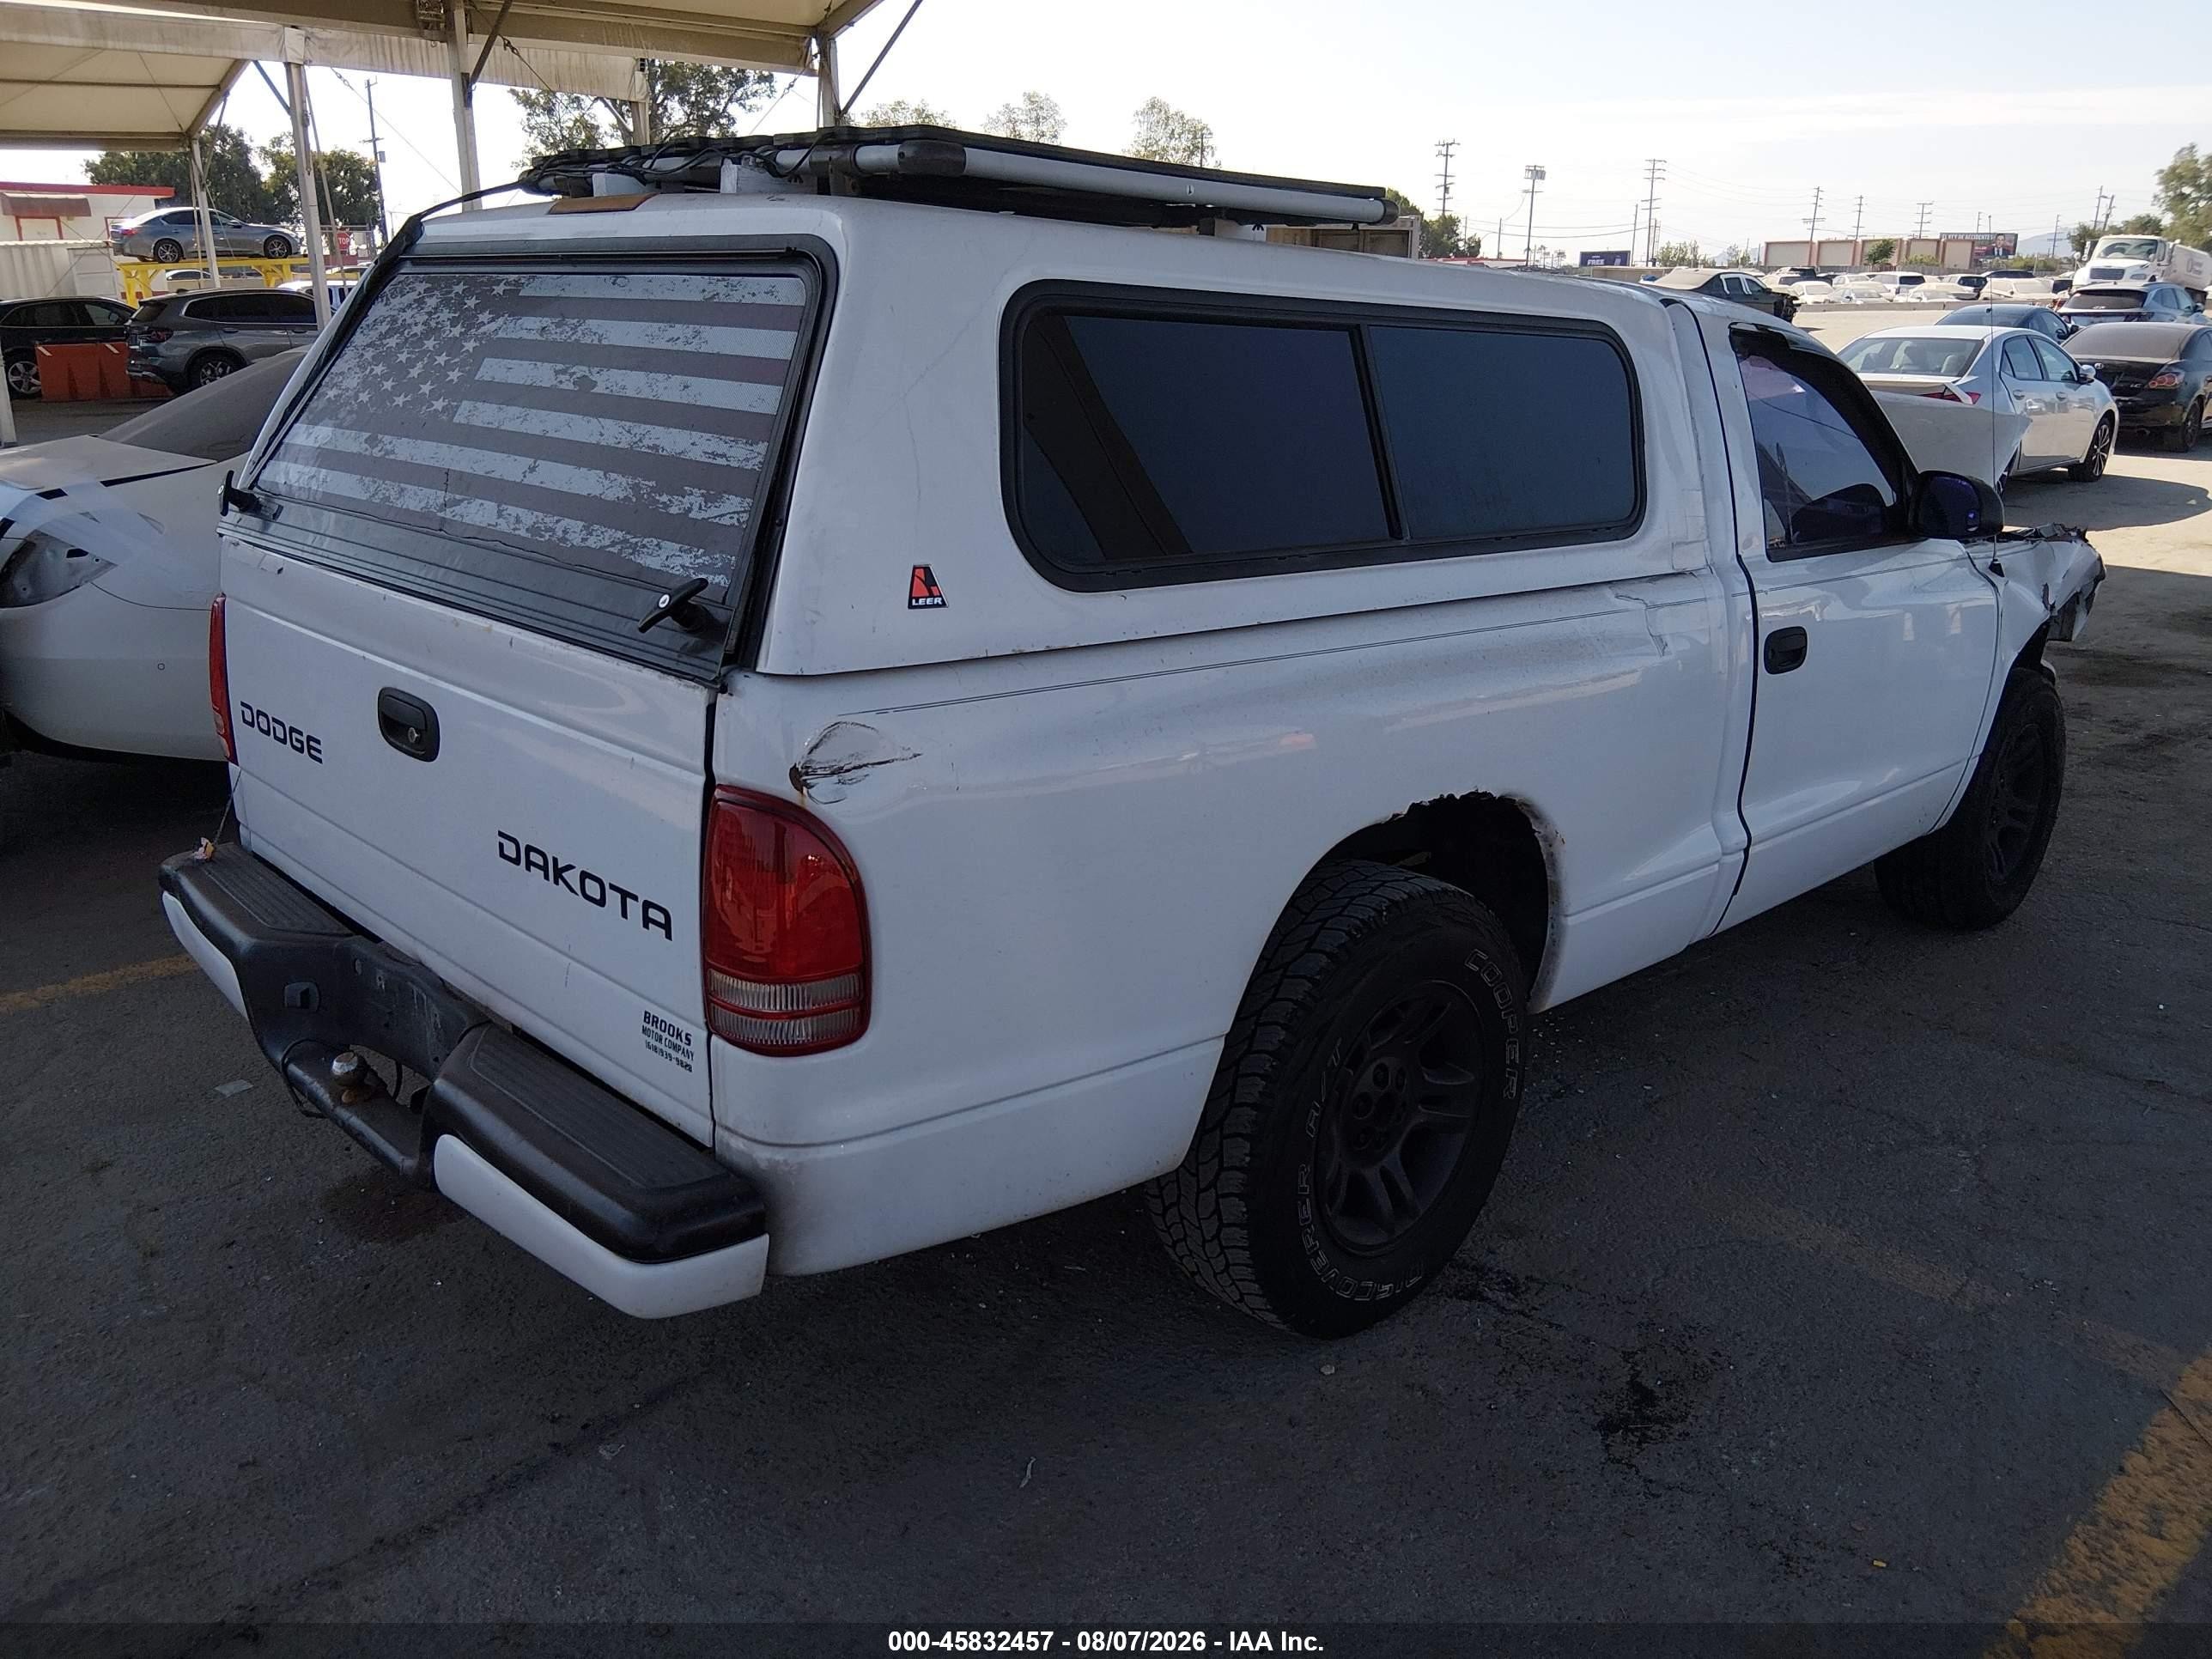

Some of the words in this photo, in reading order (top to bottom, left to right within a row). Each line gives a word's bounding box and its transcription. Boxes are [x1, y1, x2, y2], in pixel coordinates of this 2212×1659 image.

[337, 237, 350, 246] TOP
[912, 597, 943, 606] LEER
[240, 700, 324, 765] DODGE
[497, 830, 673, 942] DAKOTA
[641, 1024, 664, 1045] MOTOR
[664, 1037, 695, 1061] COMPANY
[643, 1010, 693, 1047] BROOKS
[1462, 948, 1519, 1100] COOPER
